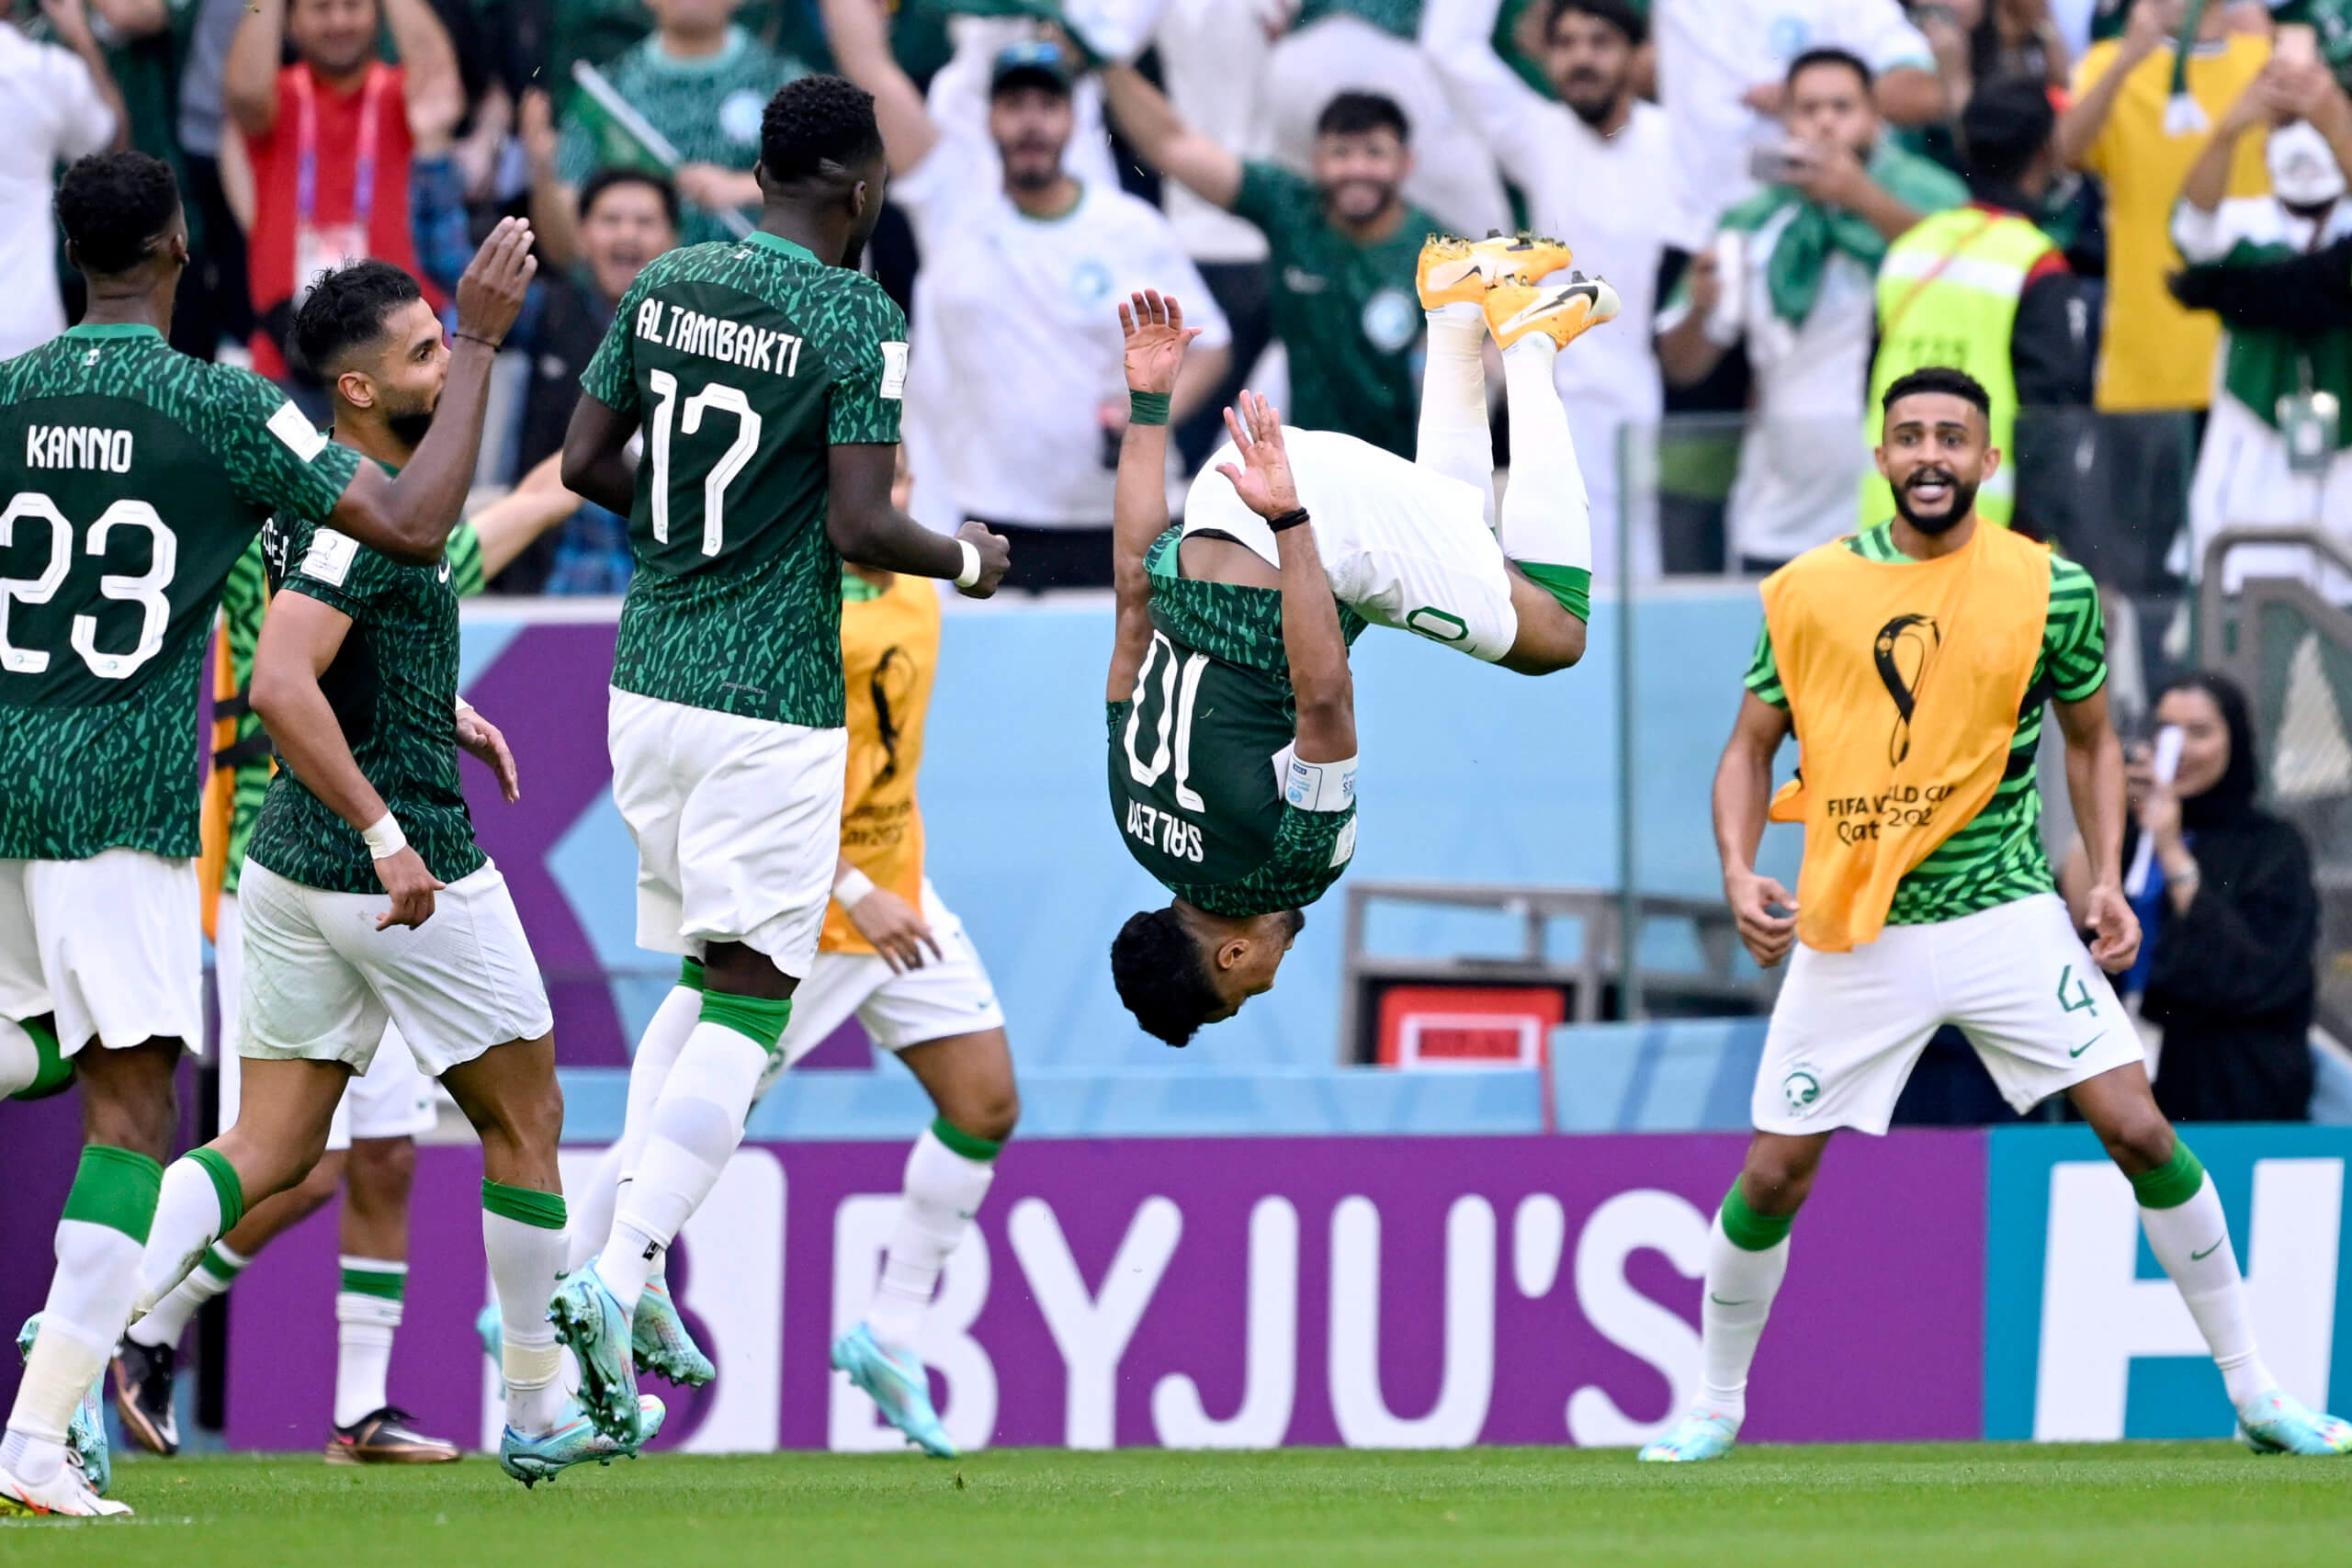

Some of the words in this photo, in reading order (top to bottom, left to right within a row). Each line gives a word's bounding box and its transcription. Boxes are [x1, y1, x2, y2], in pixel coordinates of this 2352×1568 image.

[26, 424, 133, 473] KANNO
[650, 368, 763, 557] 17
[0, 491, 177, 680] 23
[1124, 628, 1209, 813] 10
[1126, 795, 1204, 863] SALEM
[1827, 797, 1870, 817] FIFA
[2057, 964, 2098, 1018] 4
[829, 1186, 1709, 1452] BYJU'S
